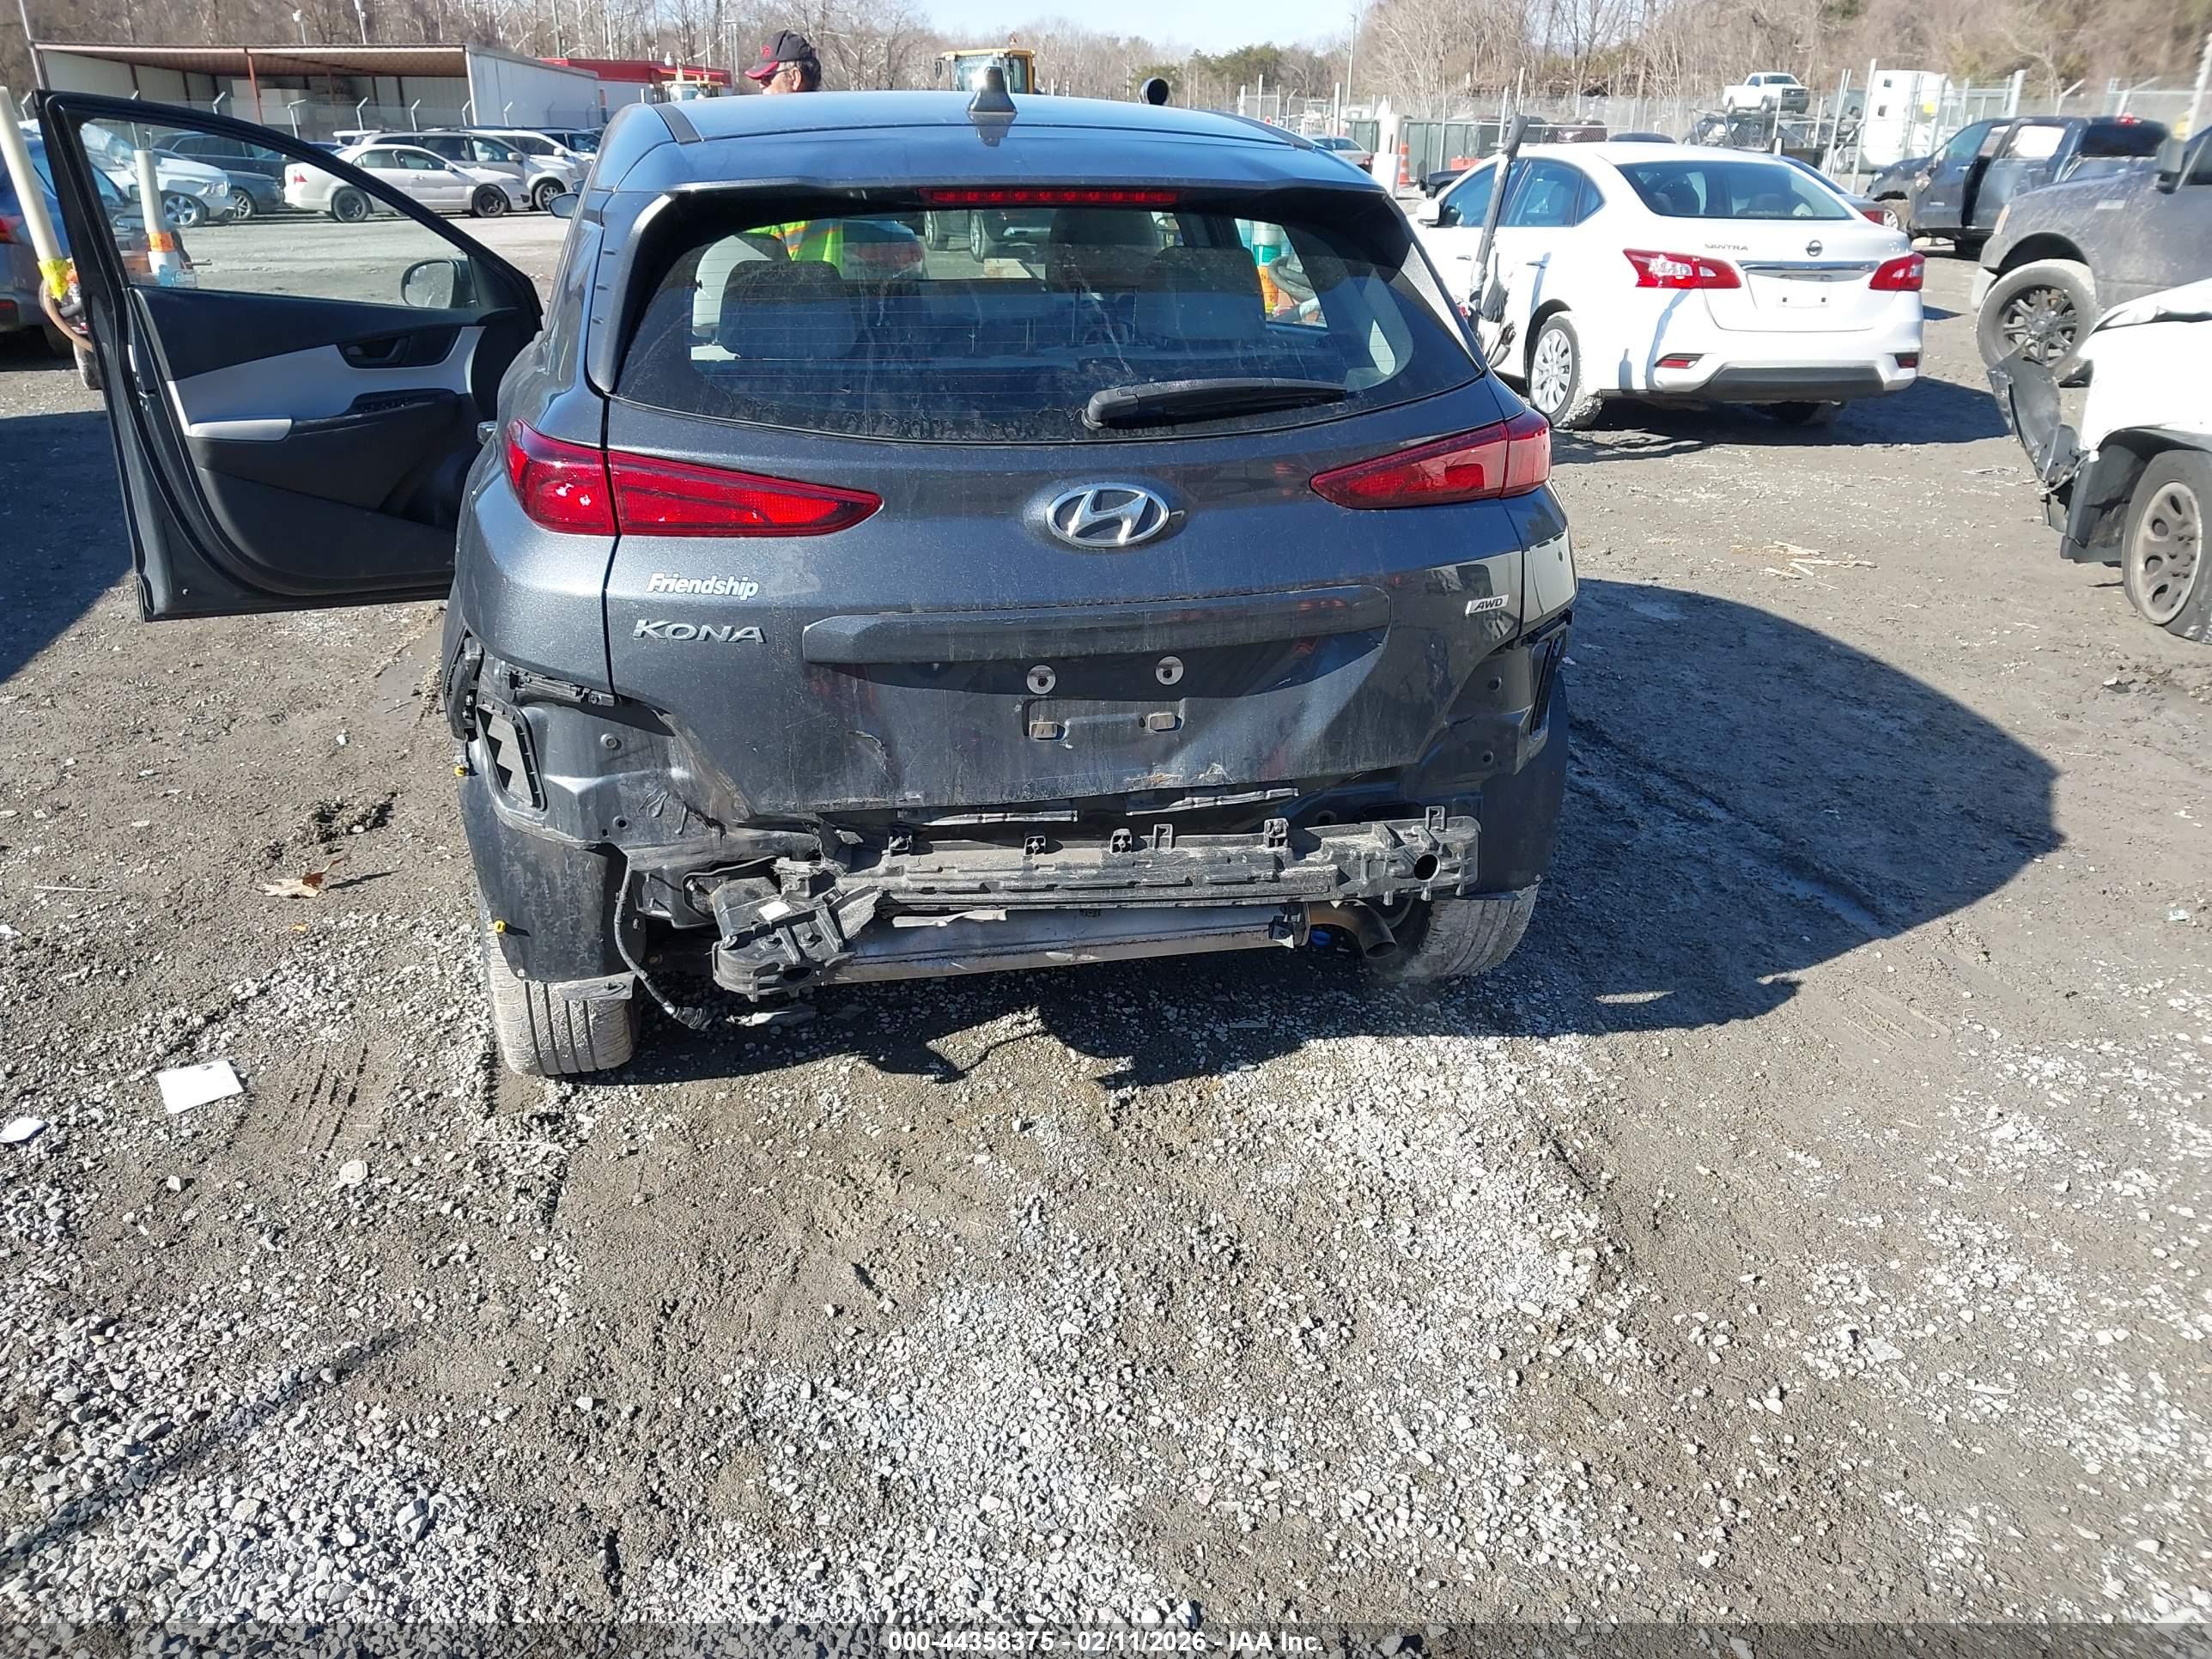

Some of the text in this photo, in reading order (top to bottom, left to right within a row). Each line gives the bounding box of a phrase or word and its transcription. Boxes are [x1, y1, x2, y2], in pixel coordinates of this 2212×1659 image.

[646, 573, 759, 600] Friendship
[1474, 598, 1503, 611] AWD
[633, 619, 767, 643] KONA
